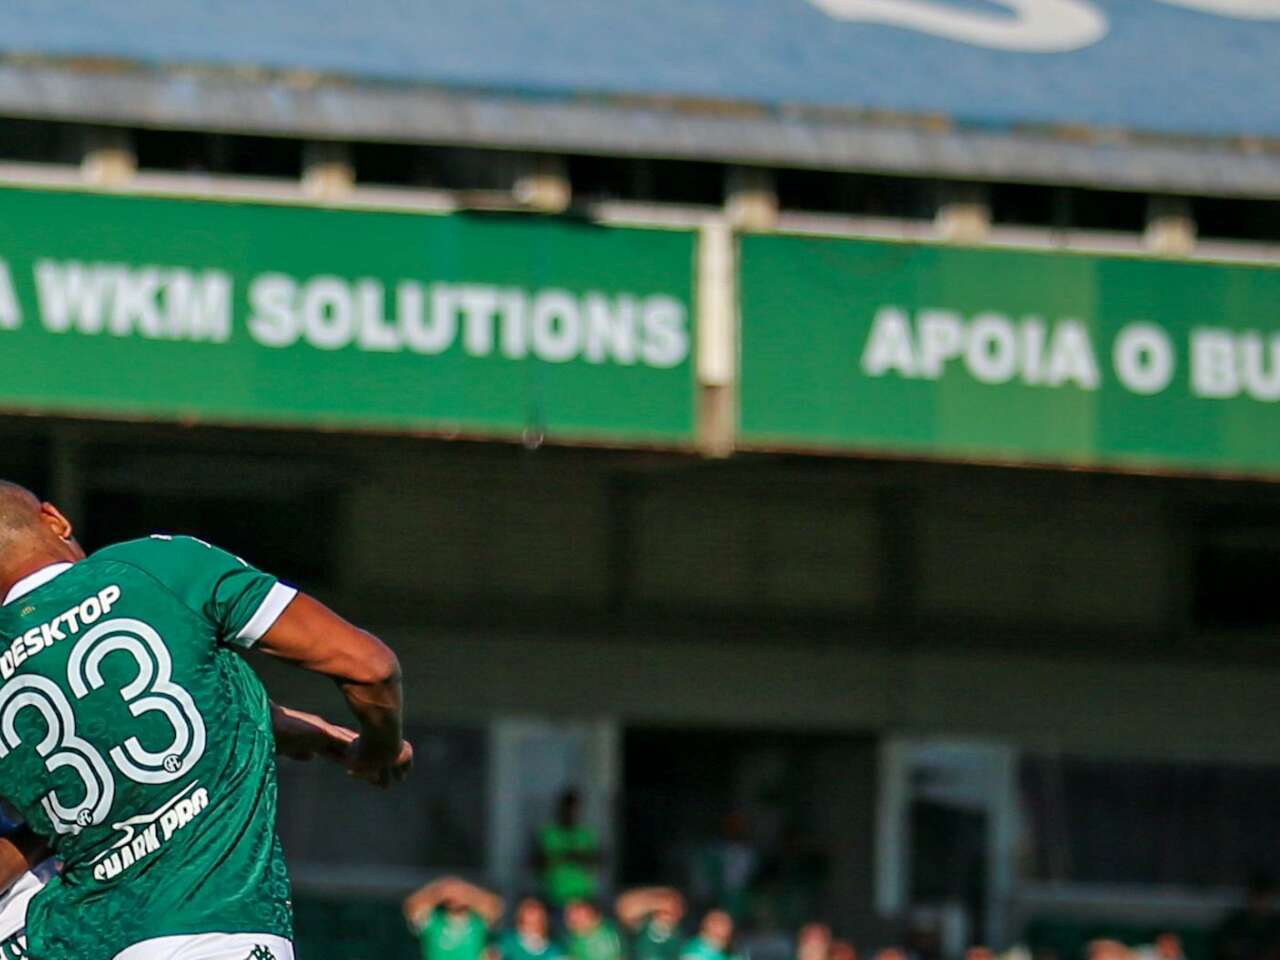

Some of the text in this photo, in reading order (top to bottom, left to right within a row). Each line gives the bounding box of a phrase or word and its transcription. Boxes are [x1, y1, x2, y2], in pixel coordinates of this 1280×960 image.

[34, 258, 233, 343] WKM
[248, 273, 689, 368] SOLUTIONS
[860, 304, 1101, 391] APOIA
[1112, 320, 1175, 396] O
